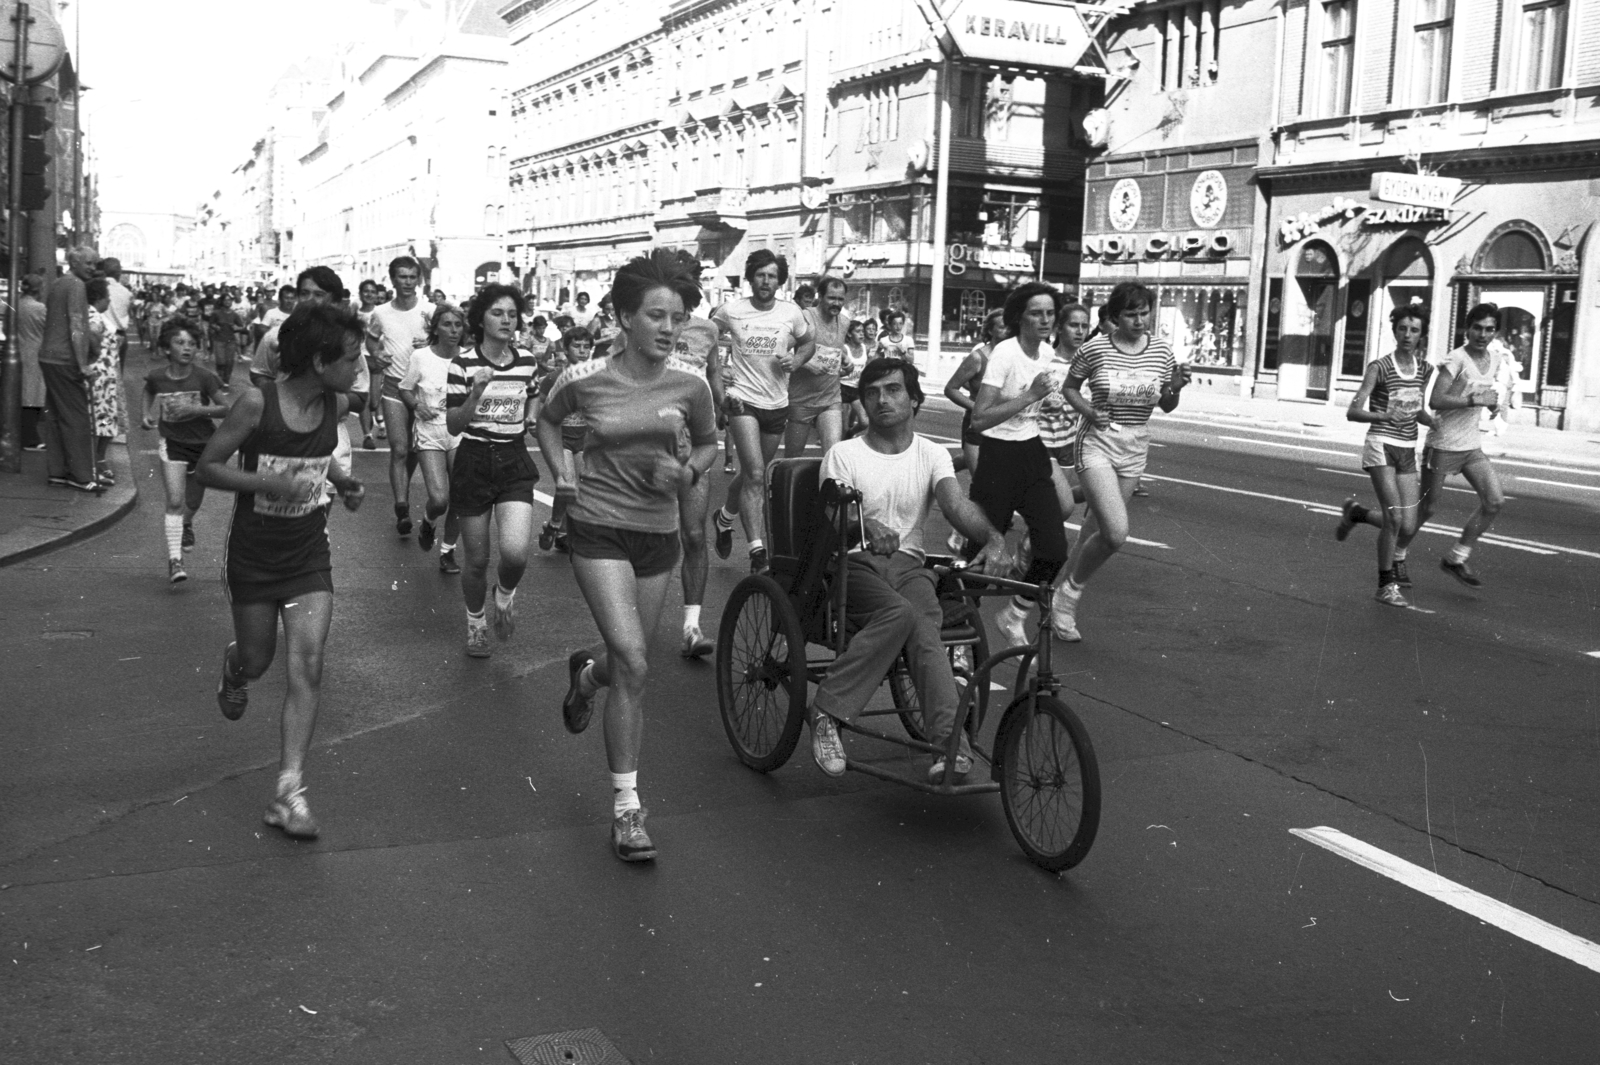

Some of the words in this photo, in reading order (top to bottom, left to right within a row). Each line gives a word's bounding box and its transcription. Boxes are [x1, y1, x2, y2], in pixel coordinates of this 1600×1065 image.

[965, 14, 1067, 46] KERAVILL
[745, 335, 778, 350] 6826
[1116, 383, 1156, 398] 2100
[478, 397, 521, 415] 5793
